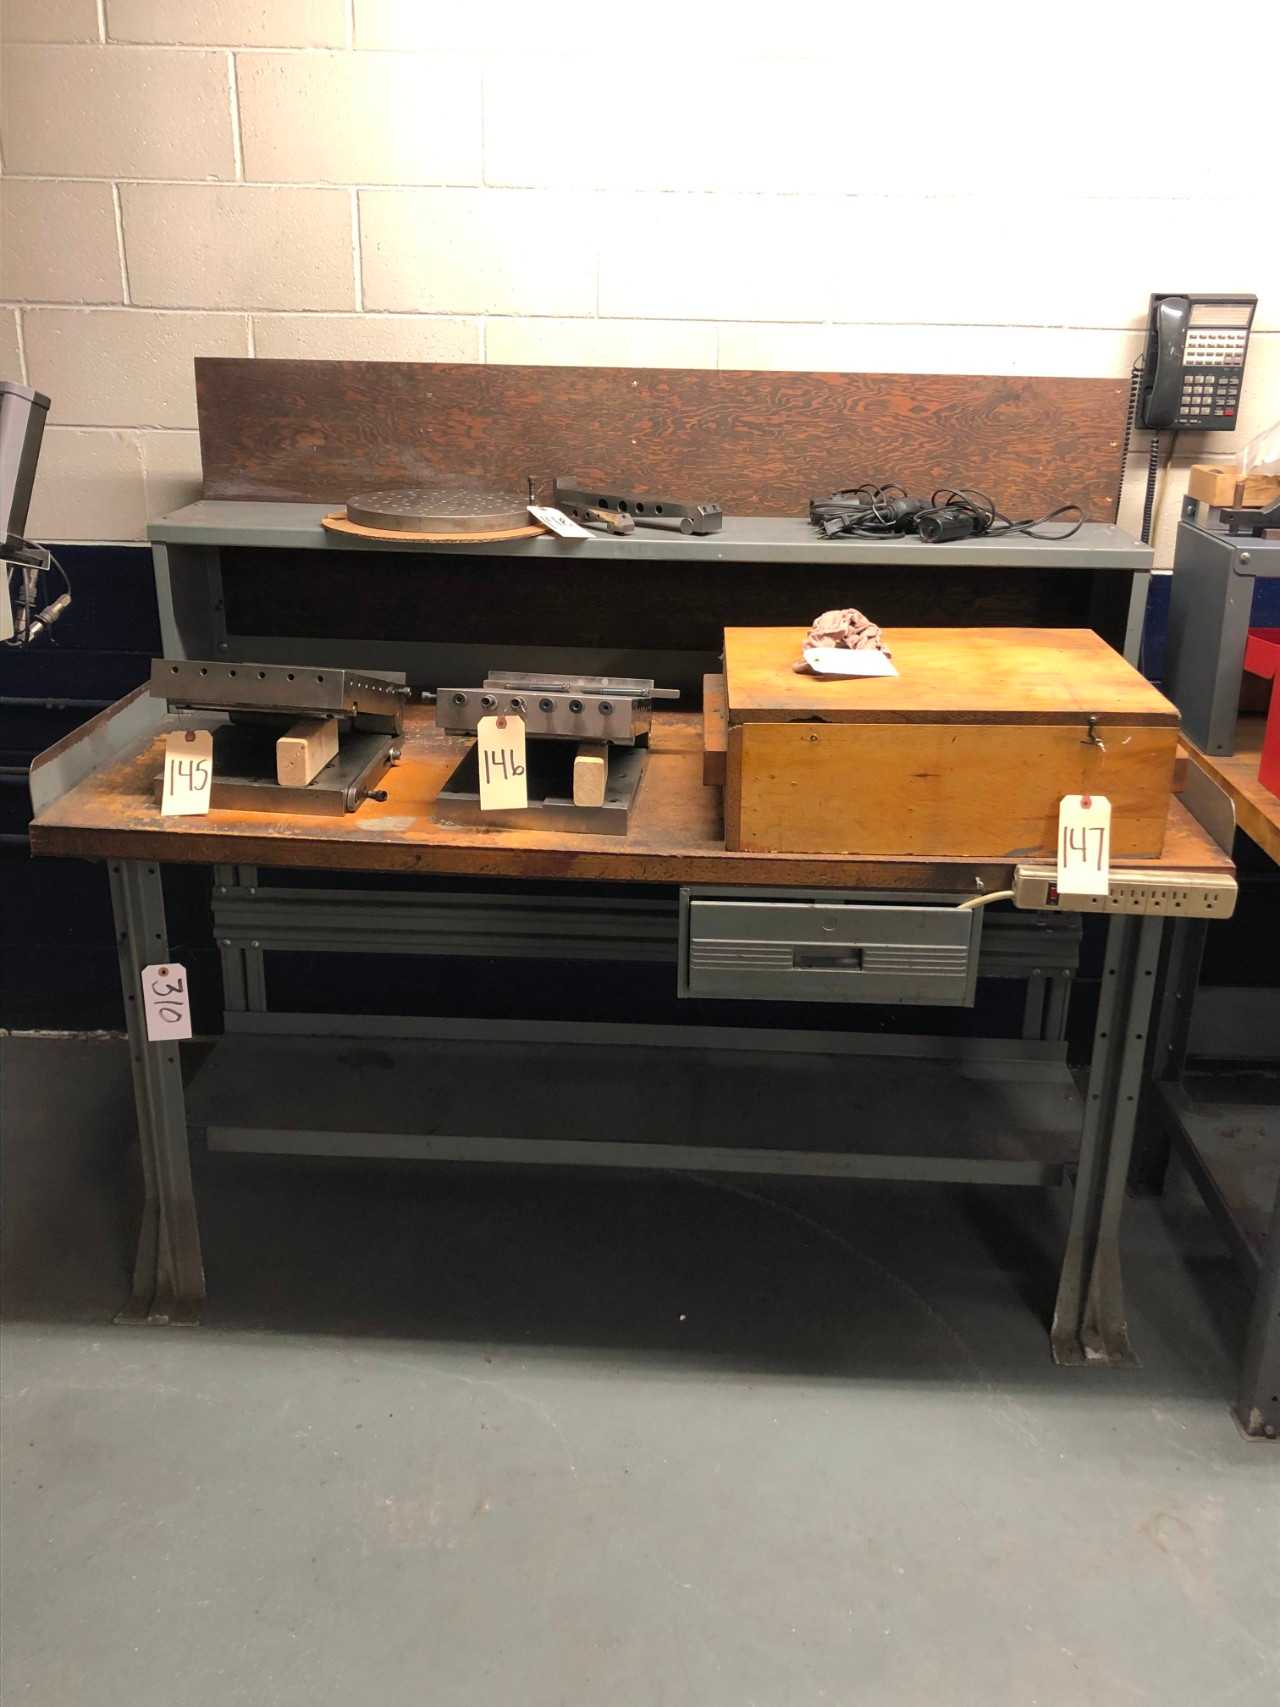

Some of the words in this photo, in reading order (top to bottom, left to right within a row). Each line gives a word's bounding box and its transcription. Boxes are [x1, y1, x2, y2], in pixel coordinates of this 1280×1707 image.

[170, 758, 209, 796] 145
[484, 748, 525, 785] 146
[1062, 825, 1105, 871] 147
[151, 978, 184, 1023] 310
